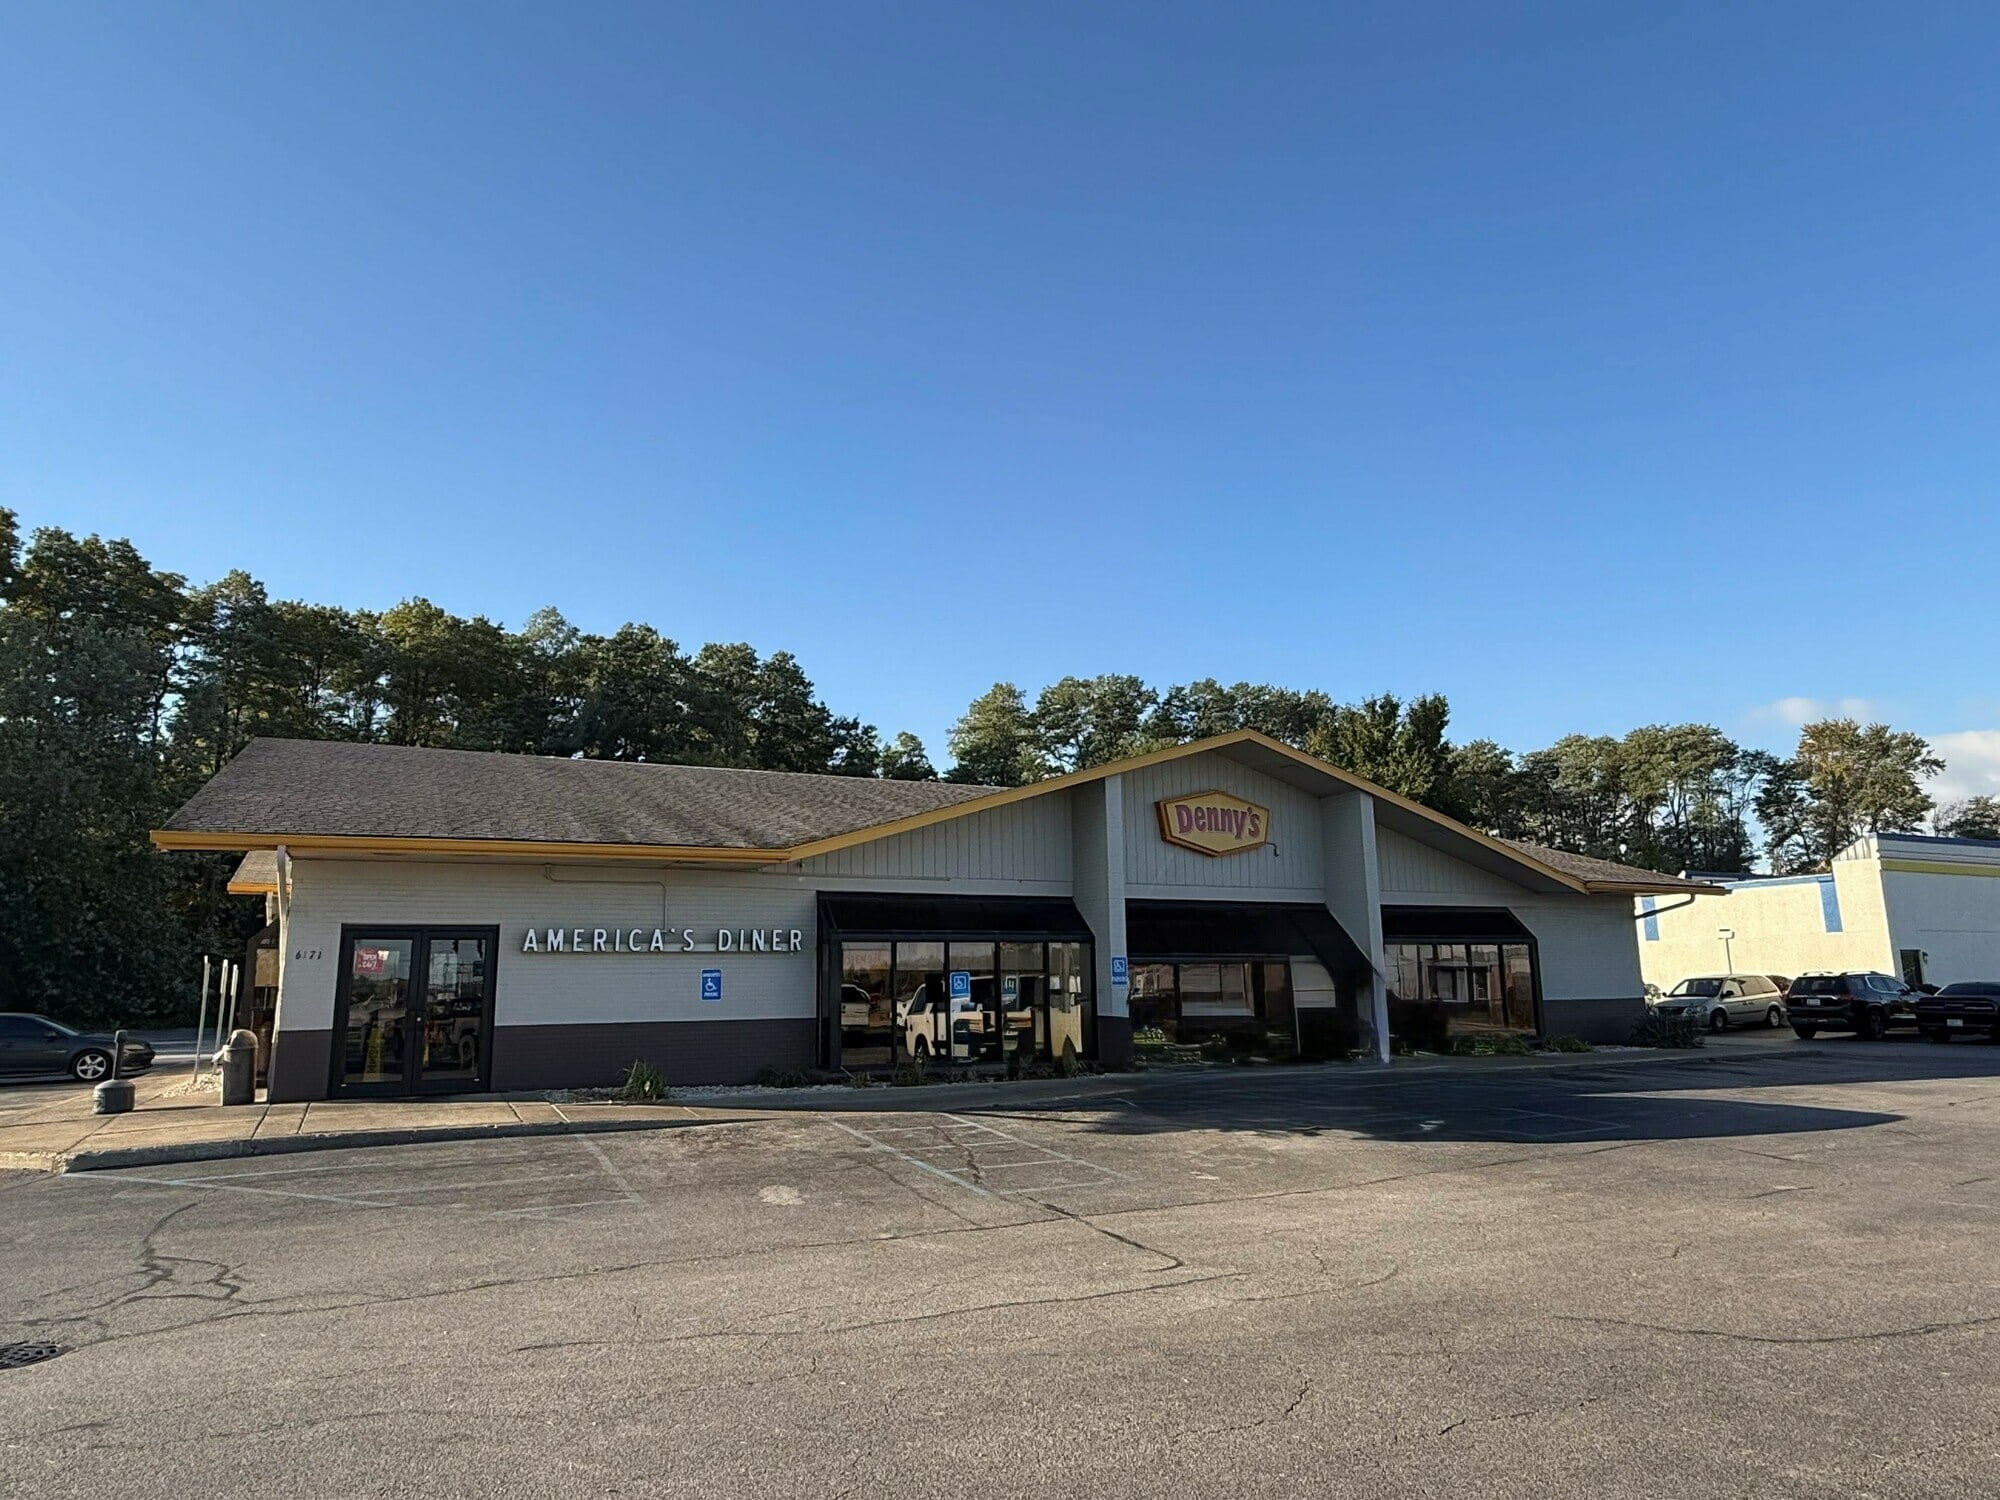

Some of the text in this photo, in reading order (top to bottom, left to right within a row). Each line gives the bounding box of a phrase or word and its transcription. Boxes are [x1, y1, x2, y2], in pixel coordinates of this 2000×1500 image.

[1174, 804, 1261, 840] Denny's
[522, 928, 802, 952] AMERICA'S DINER
